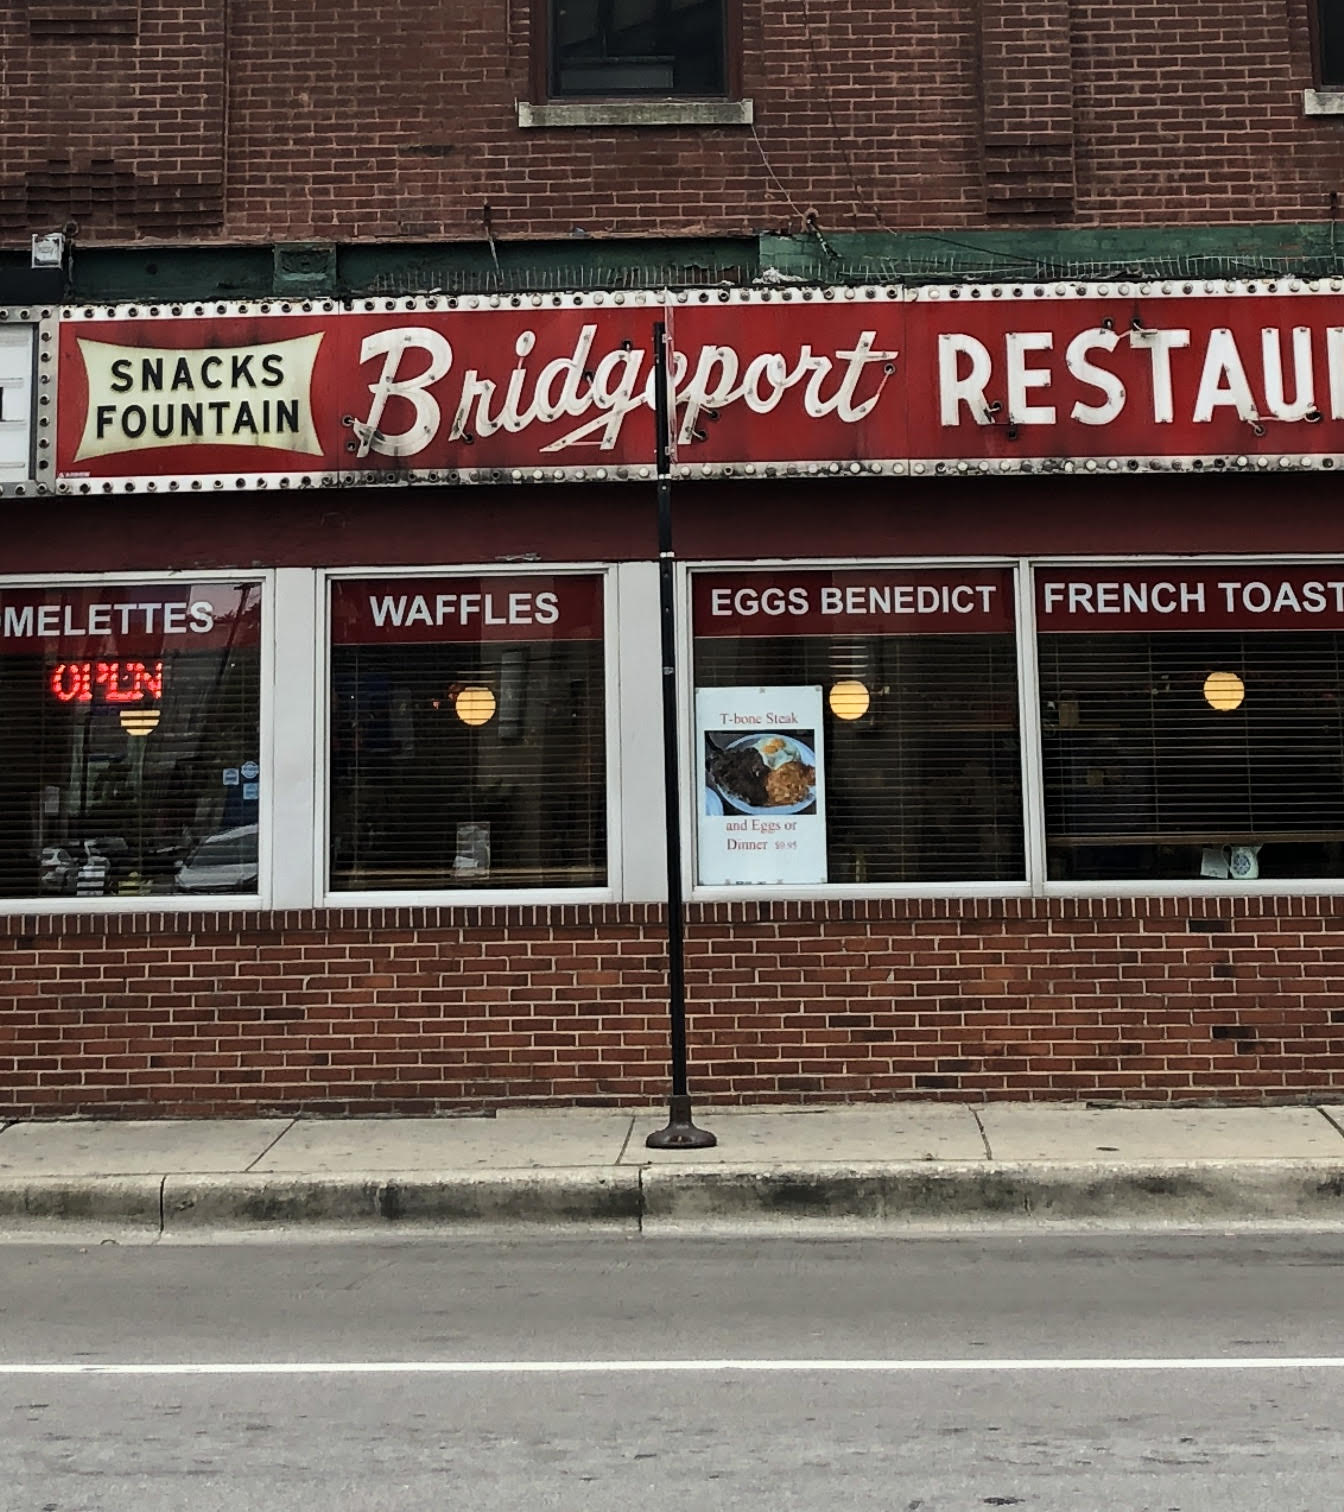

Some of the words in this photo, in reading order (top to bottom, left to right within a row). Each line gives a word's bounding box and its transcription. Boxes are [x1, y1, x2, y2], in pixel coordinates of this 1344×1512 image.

[110, 353, 285, 392] SNACKS
[355, 324, 898, 458] Bridgeport
[96, 399, 300, 438] FOUNTAIN
[369, 592, 560, 627] WAFFLES
[711, 588, 809, 616] EGGS
[821, 585, 997, 614] BENEDICT
[1044, 582, 1206, 615] FRENCH
[720, 712, 762, 725] T-bone
[766, 712, 799, 725] Steak
[726, 819, 748, 831] and
[752, 820, 781, 834] Eggs
[784, 821, 797, 831] or
[727, 838, 768, 850] Dinner
